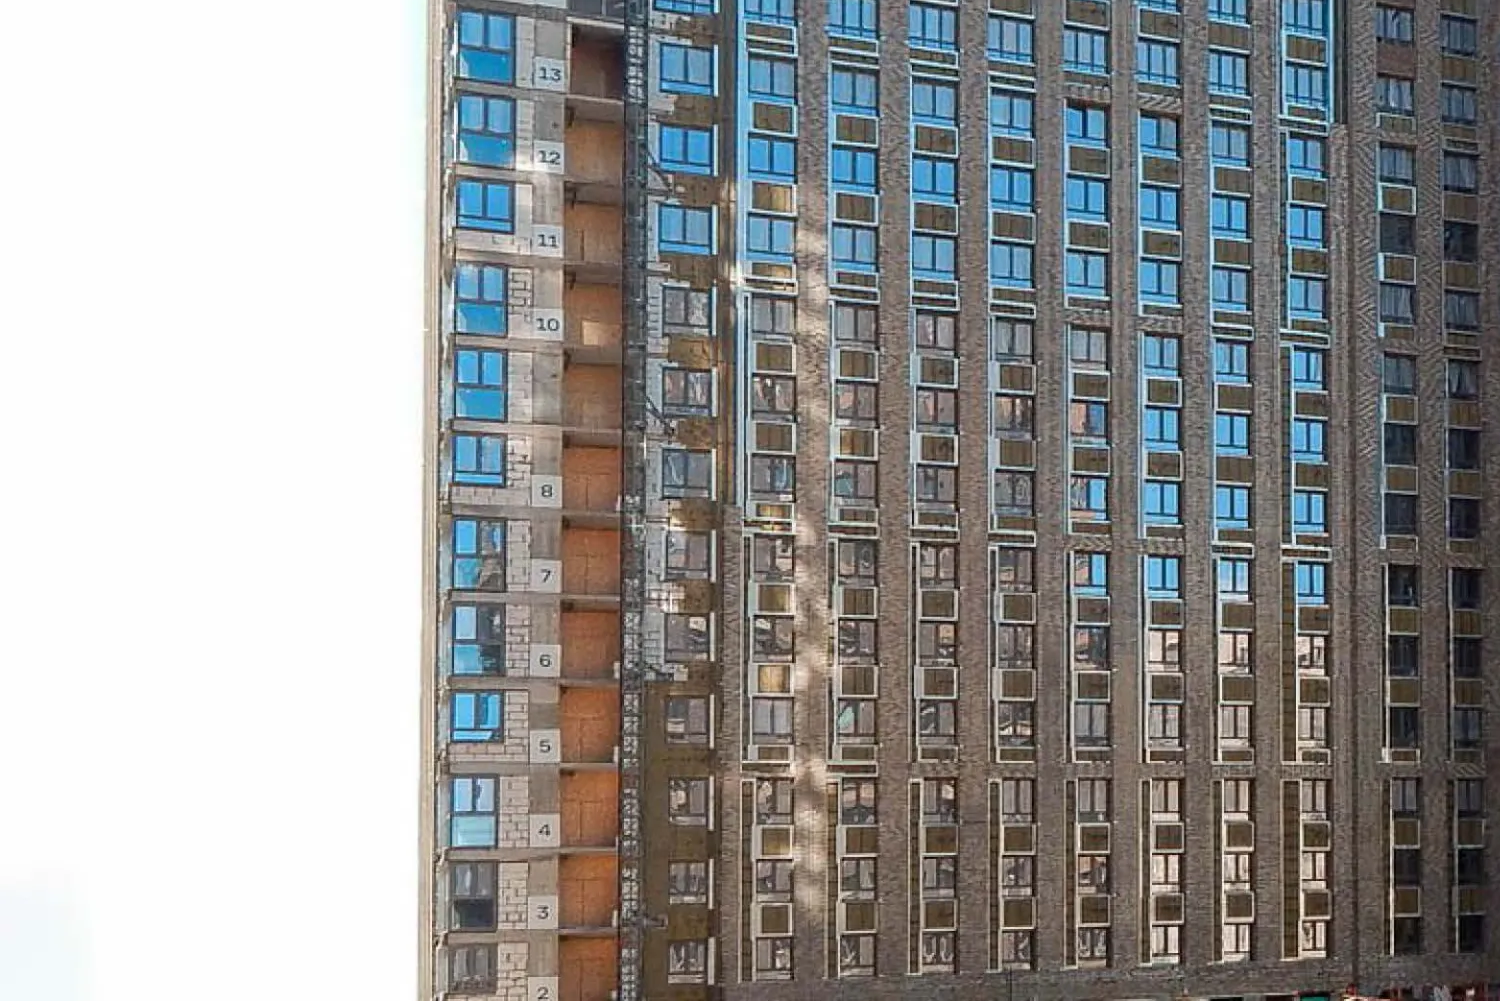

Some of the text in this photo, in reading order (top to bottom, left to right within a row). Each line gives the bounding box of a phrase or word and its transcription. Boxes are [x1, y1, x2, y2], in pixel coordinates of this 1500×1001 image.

[539, 66, 561, 82] 13
[538, 150, 561, 166] 12
[537, 234, 559, 249] 11
[536, 318, 560, 332] 10
[540, 568, 552, 583] 7
[539, 739, 551, 753] 5
[538, 824, 551, 837] 4
[537, 904, 549, 919] 3
[537, 986, 549, 1000] 2
